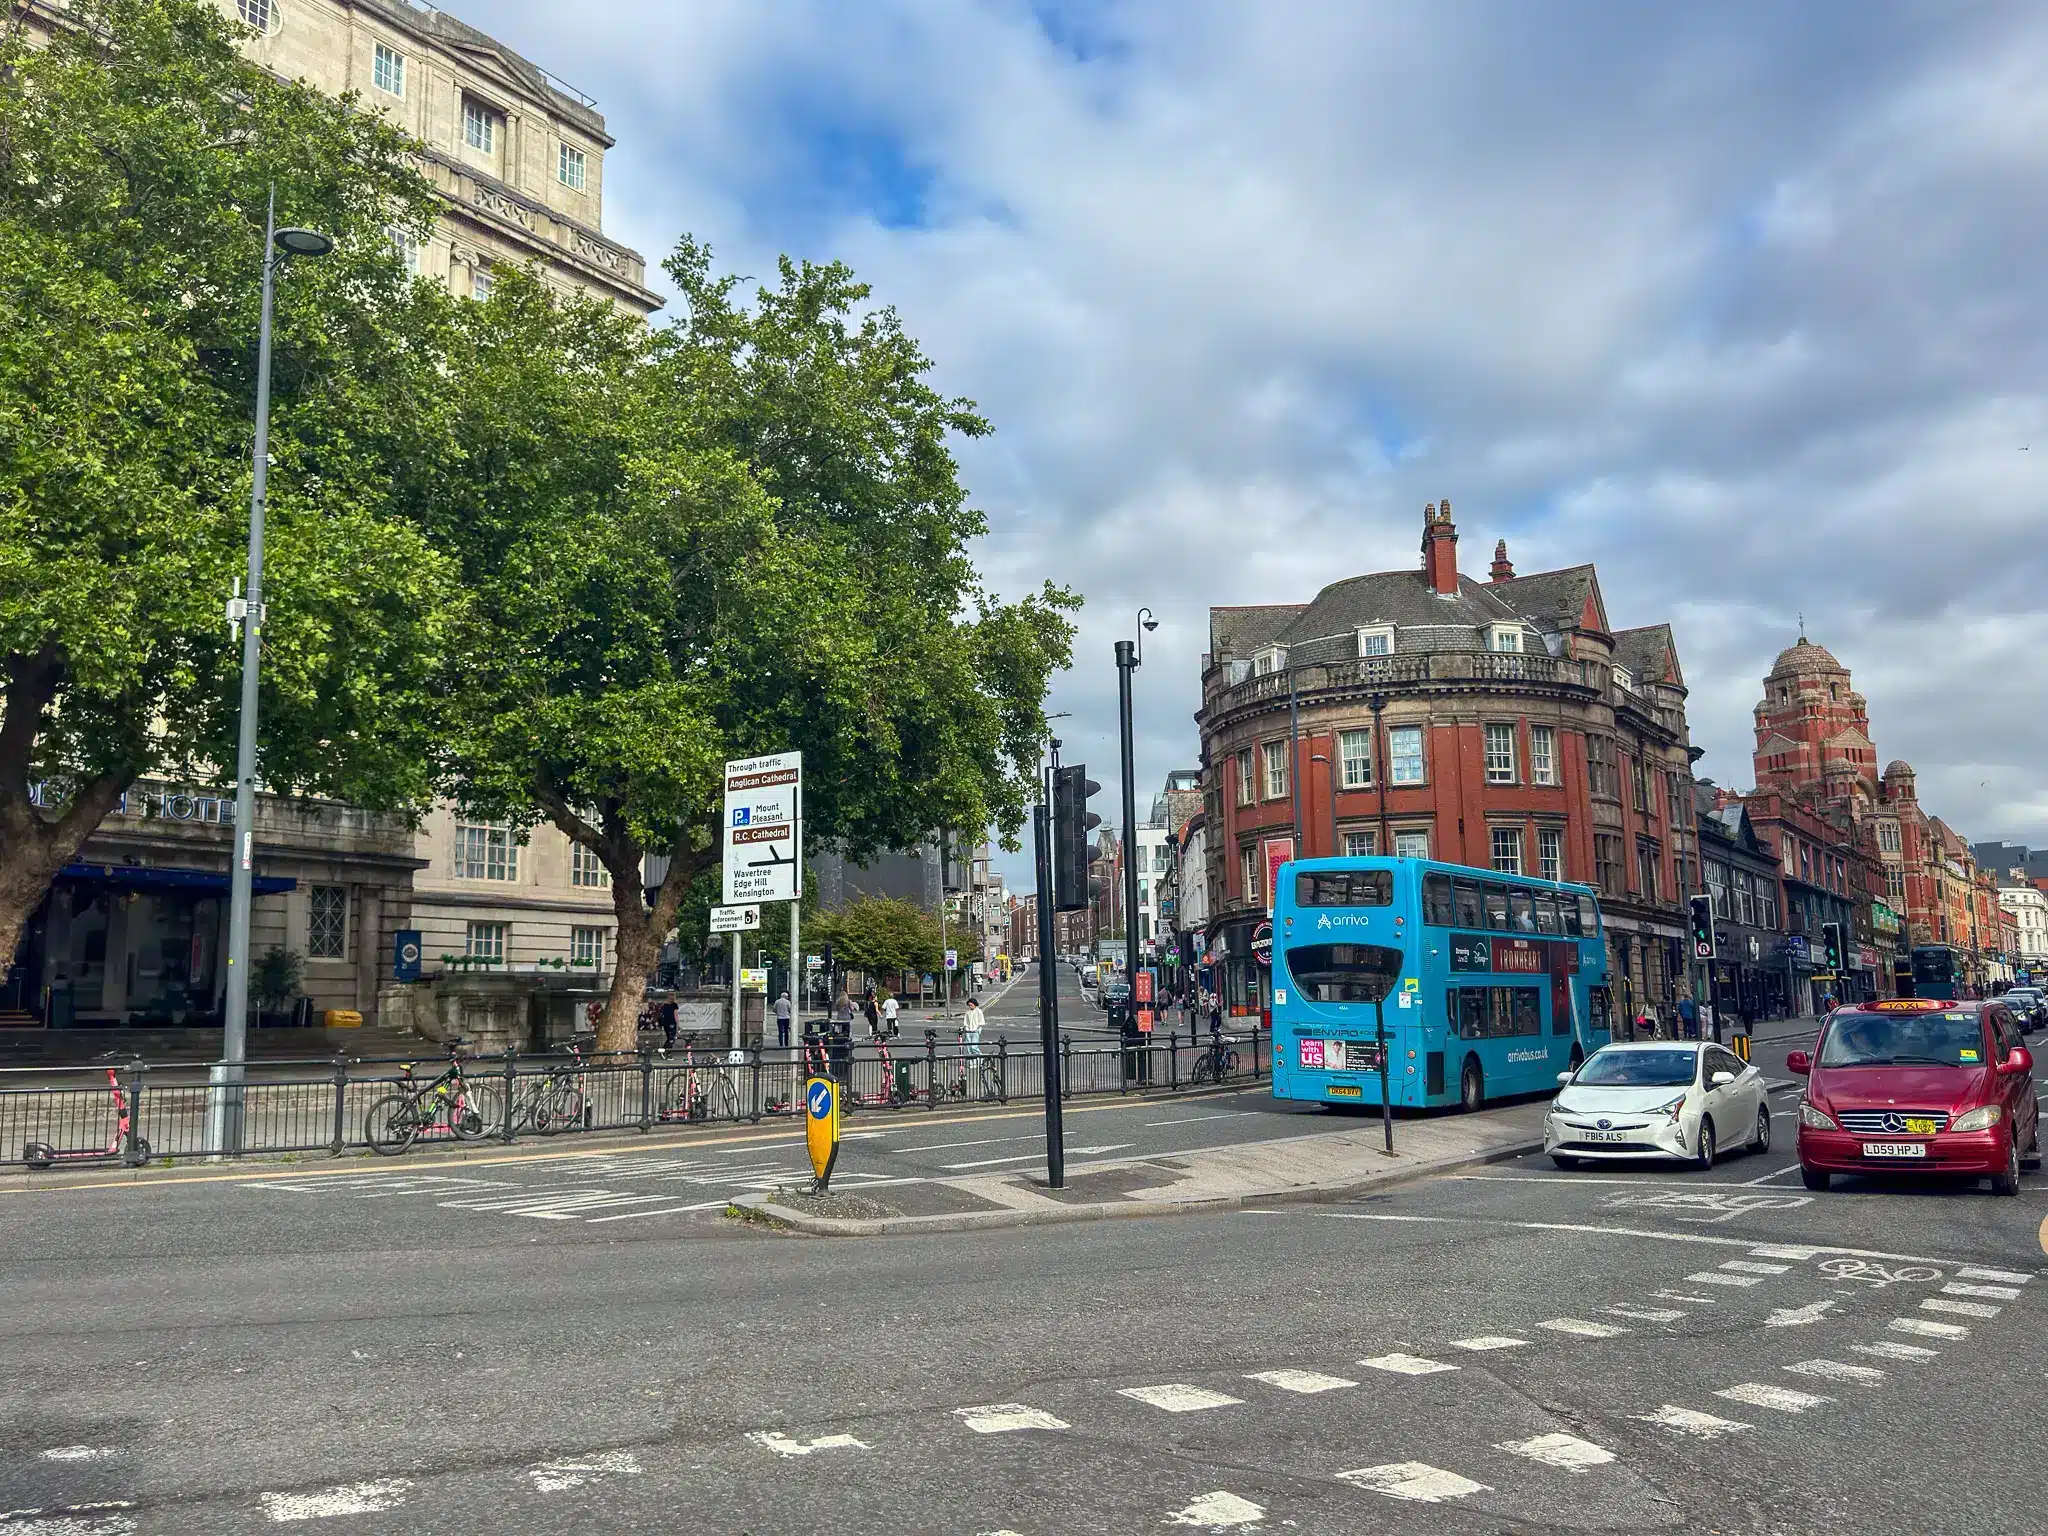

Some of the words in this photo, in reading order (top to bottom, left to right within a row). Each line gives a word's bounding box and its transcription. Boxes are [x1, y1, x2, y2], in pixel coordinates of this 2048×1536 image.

[728, 761, 757, 773] Through
[759, 758, 782, 769] traffic
[729, 777, 760, 789] Anglican
[761, 770, 797, 784] Cathedral
[755, 802, 780, 813] Mount
[751, 812, 783, 823] Pleasant
[734, 832, 750, 841] R.C.
[751, 827, 788, 840] Cathedral
[733, 868, 772, 879] Wavertree
[733, 880, 752, 889] Edge
[754, 877, 768, 887] Hill
[733, 888, 775, 899] Kensington
[711, 914, 743, 923] enforcement
[1332, 914, 1369, 926] arriva
[716, 922, 738, 930] cameras
[1499, 948, 1541, 971] IRONHEART
[1888, 1002, 1919, 1010] TAXI
[1301, 1039, 1324, 1047] Learn
[1301, 1045, 1320, 1053] with
[1507, 1045, 1549, 1063] arrivabus.co.uk
[1301, 1053, 1324, 1065] us
[1585, 1132, 1604, 1141] FB15
[1605, 1132, 1623, 1142] ALS
[1865, 1144, 1895, 1155] LD59
[1896, 1145, 1919, 1156] HPJ
